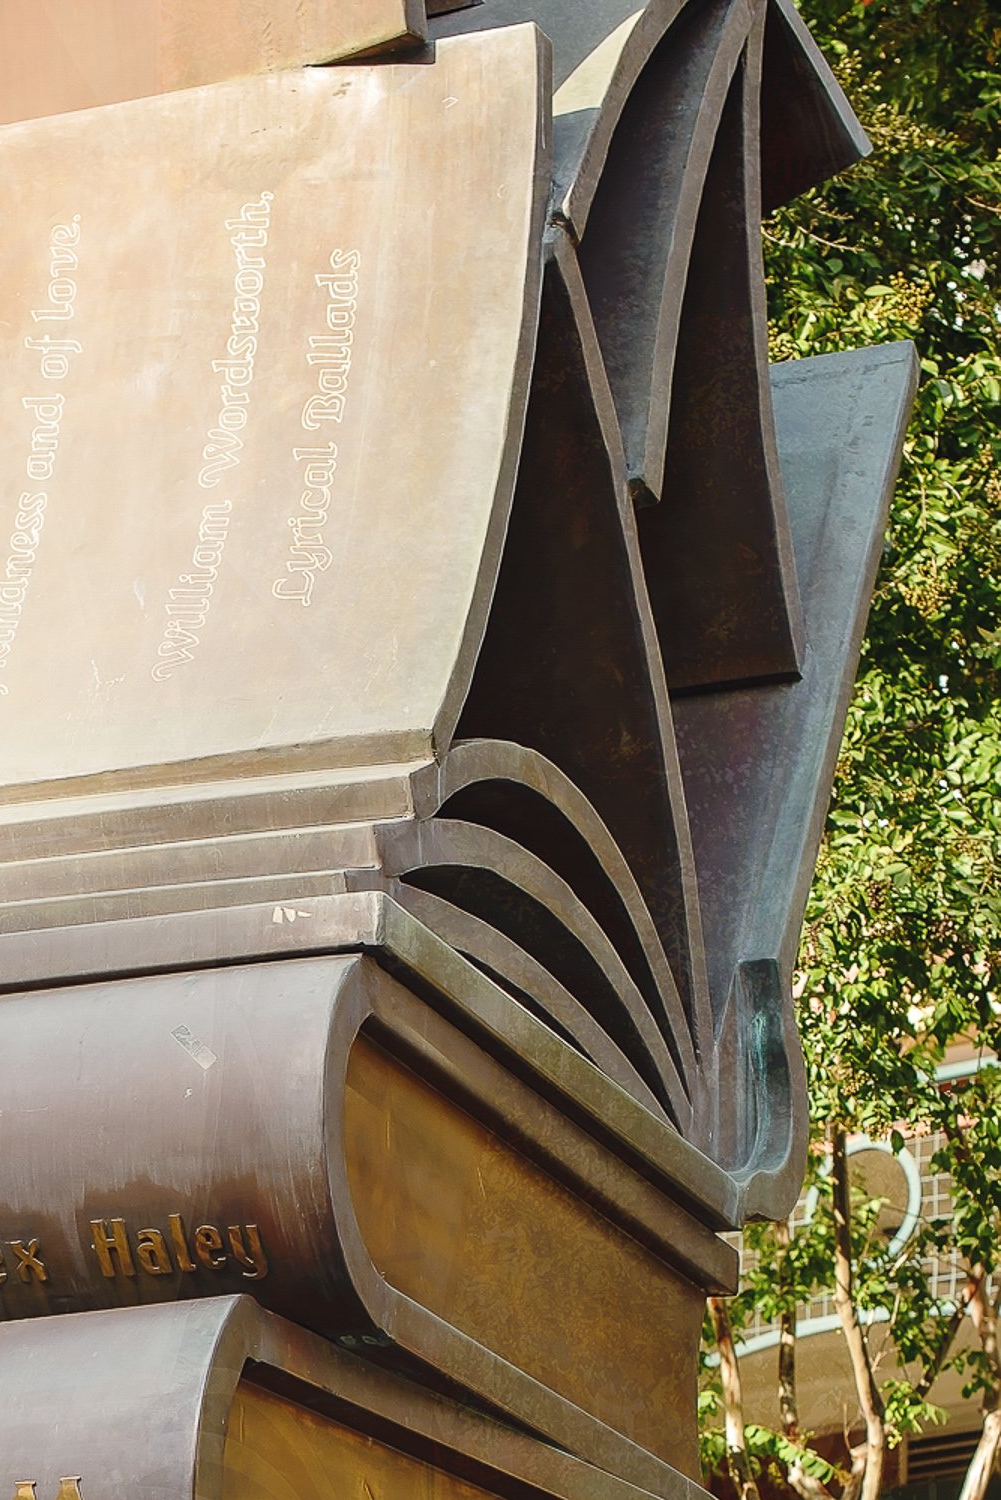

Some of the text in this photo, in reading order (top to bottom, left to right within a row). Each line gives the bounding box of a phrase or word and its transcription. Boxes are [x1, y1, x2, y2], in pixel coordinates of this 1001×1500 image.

[31, 213, 82, 322] love.
[25, 335, 82, 380] of
[21, 394, 67, 481] and
[151, 191, 275, 682] William Wordsworth,
[273, 248, 361, 606] Lyrical Ballads
[90, 1212, 270, 1280] Haley
